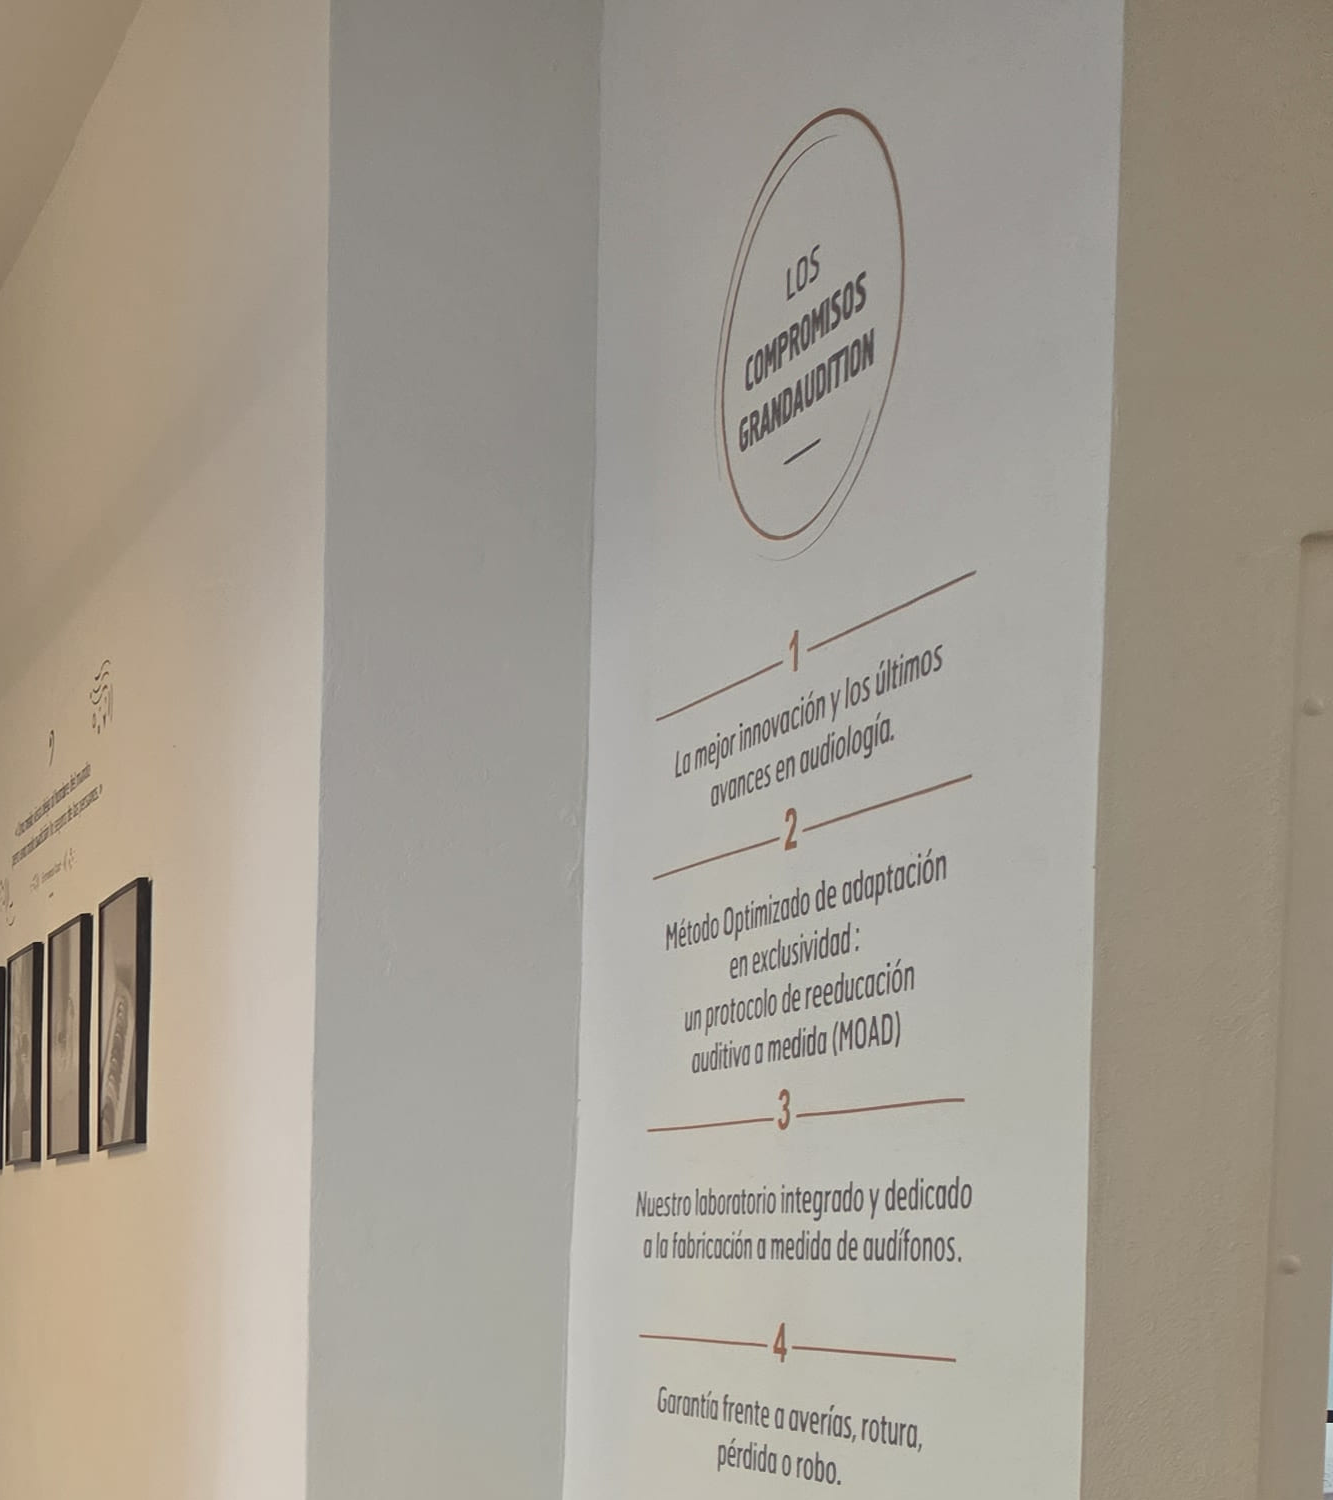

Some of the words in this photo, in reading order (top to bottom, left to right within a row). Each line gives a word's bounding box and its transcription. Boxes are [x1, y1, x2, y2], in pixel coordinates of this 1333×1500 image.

[785, 244, 821, 302] LOS
[744, 271, 868, 392] COMPROMISOS
[738, 328, 876, 453] GRANDAUDITION
[789, 629, 799, 672] 1
[675, 750, 691, 778] La
[695, 732, 736, 770] mejor
[739, 690, 825, 752] innovación
[830, 689, 841, 722] y
[845, 676, 870, 709] los
[876, 644, 943, 696] últimos
[711, 764, 771, 807] avances
[776, 755, 795, 783] en
[800, 714, 894, 774] audiología.
[784, 807, 798, 851] 2
[666, 912, 719, 951] Método
[723, 887, 810, 941] Optimizado
[815, 880, 837, 912] de
[842, 849, 947, 906] adaptación
[730, 955, 748, 979] en
[752, 922, 851, 974] exclusividad
[685, 1009, 701, 1032] un
[705, 988, 777, 1036] protocolo
[782, 983, 801, 1014] de
[805, 962, 915, 1010] reeducación
[692, 1040, 750, 1073] auditiva
[755, 1042, 763, 1064] a
[768, 1025, 827, 1062] medida
[832, 1010, 900, 1056] (MOAD)
[777, 1088, 791, 1131] 3
[636, 1191, 691, 1217] Nuestro
[695, 1185, 776, 1216] laboratorio
[781, 1181, 864, 1222] integrado
[869, 1188, 880, 1220] y
[885, 1176, 972, 1211] dedicado
[643, 1239, 652, 1258] a
[656, 1232, 668, 1259] la
[672, 1229, 752, 1260] fabricación
[757, 1238, 766, 1260] a
[771, 1230, 831, 1261] medida
[837, 1229, 858, 1261] de
[863, 1227, 962, 1263] audífonos.
[772, 1321, 787, 1363] 4
[657, 1386, 718, 1420] Garantía
[723, 1394, 770, 1428] frente
[774, 1407, 785, 1429] a
[789, 1404, 856, 1443] averías,
[861, 1416, 922, 1453] rotura,
[717, 1438, 777, 1474] pérdida
[782, 1455, 792, 1477] o
[796, 1451, 841, 1485] robo.
